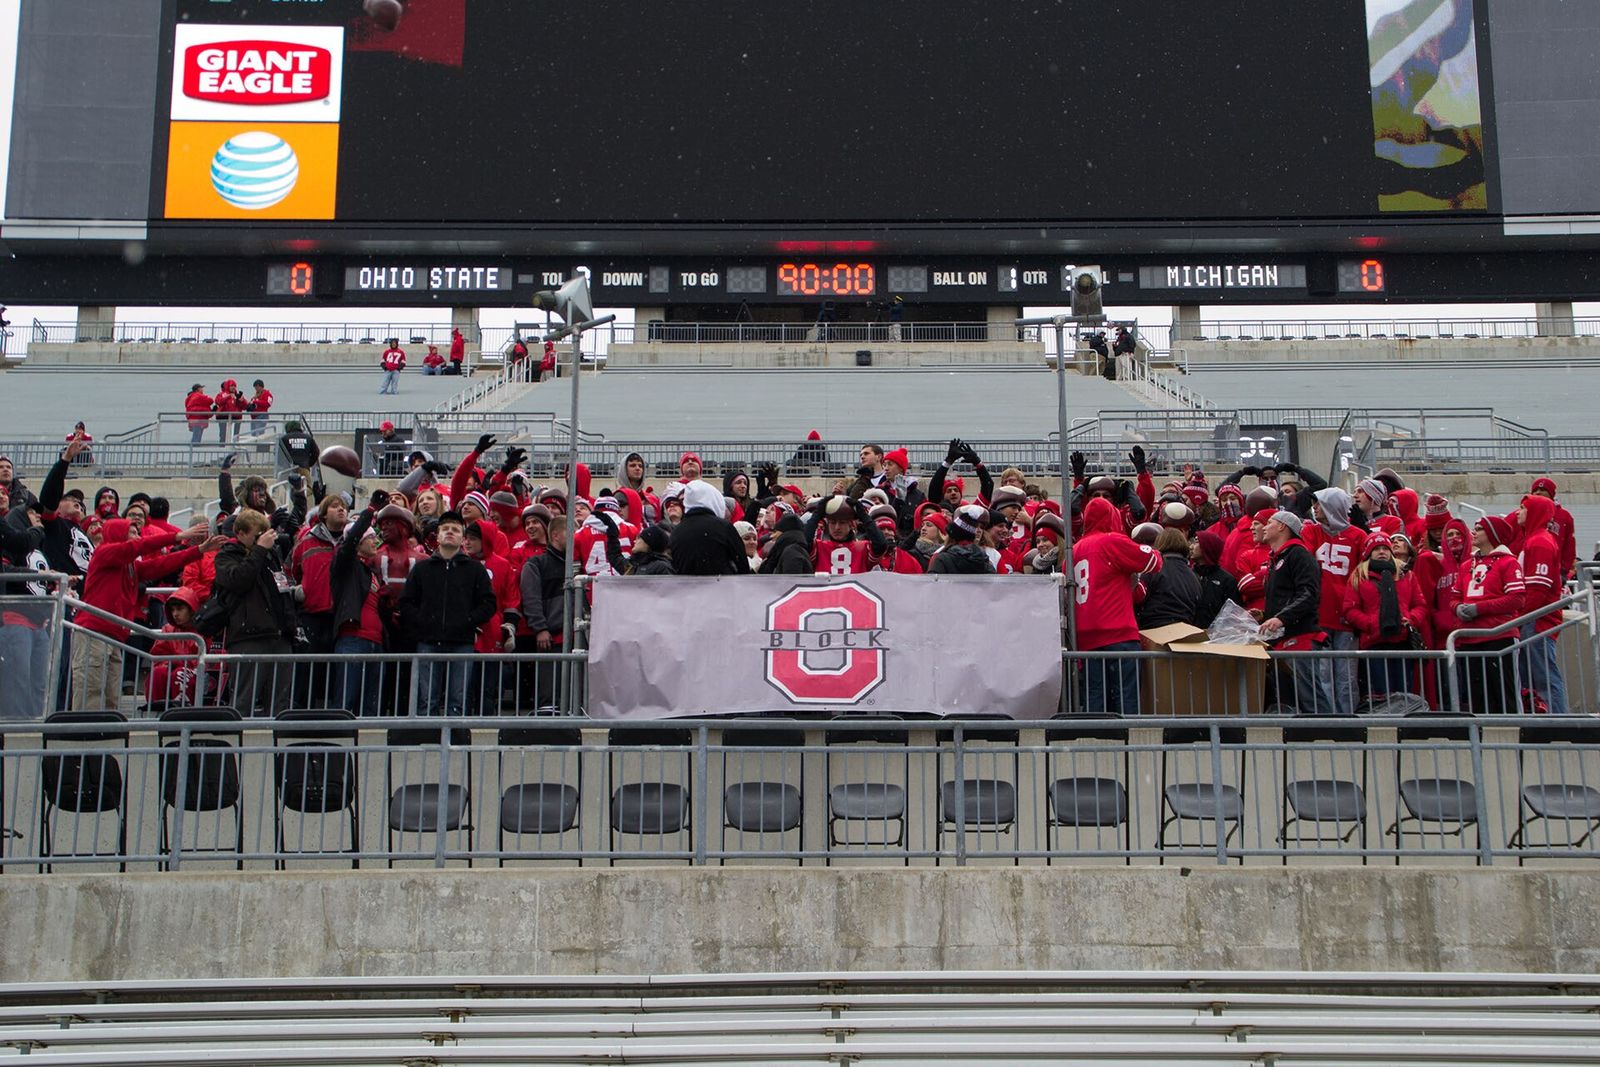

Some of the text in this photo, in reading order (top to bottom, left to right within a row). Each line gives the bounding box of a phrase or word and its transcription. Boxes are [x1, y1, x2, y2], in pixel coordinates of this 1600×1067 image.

[197, 50, 317, 72] GIANT
[199, 72, 312, 94] EAGLE
[290, 263, 312, 294] 0
[359, 267, 499, 289] OHIO STATE
[542, 272, 565, 286] TOL
[602, 272, 643, 286] DOWN
[681, 272, 719, 286] TO GO
[779, 263, 874, 295] 90:00
[933, 271, 987, 286] BALL ON
[1023, 271, 1048, 285] QTR
[1167, 265, 1278, 287] MICHIGAN
[1361, 260, 1383, 291] 0
[831, 547, 852, 574] 8
[1315, 542, 1352, 576] 45
[1535, 563, 1549, 575] 10
[1467, 564, 1488, 597] 2
[769, 631, 884, 648] BLOCK
